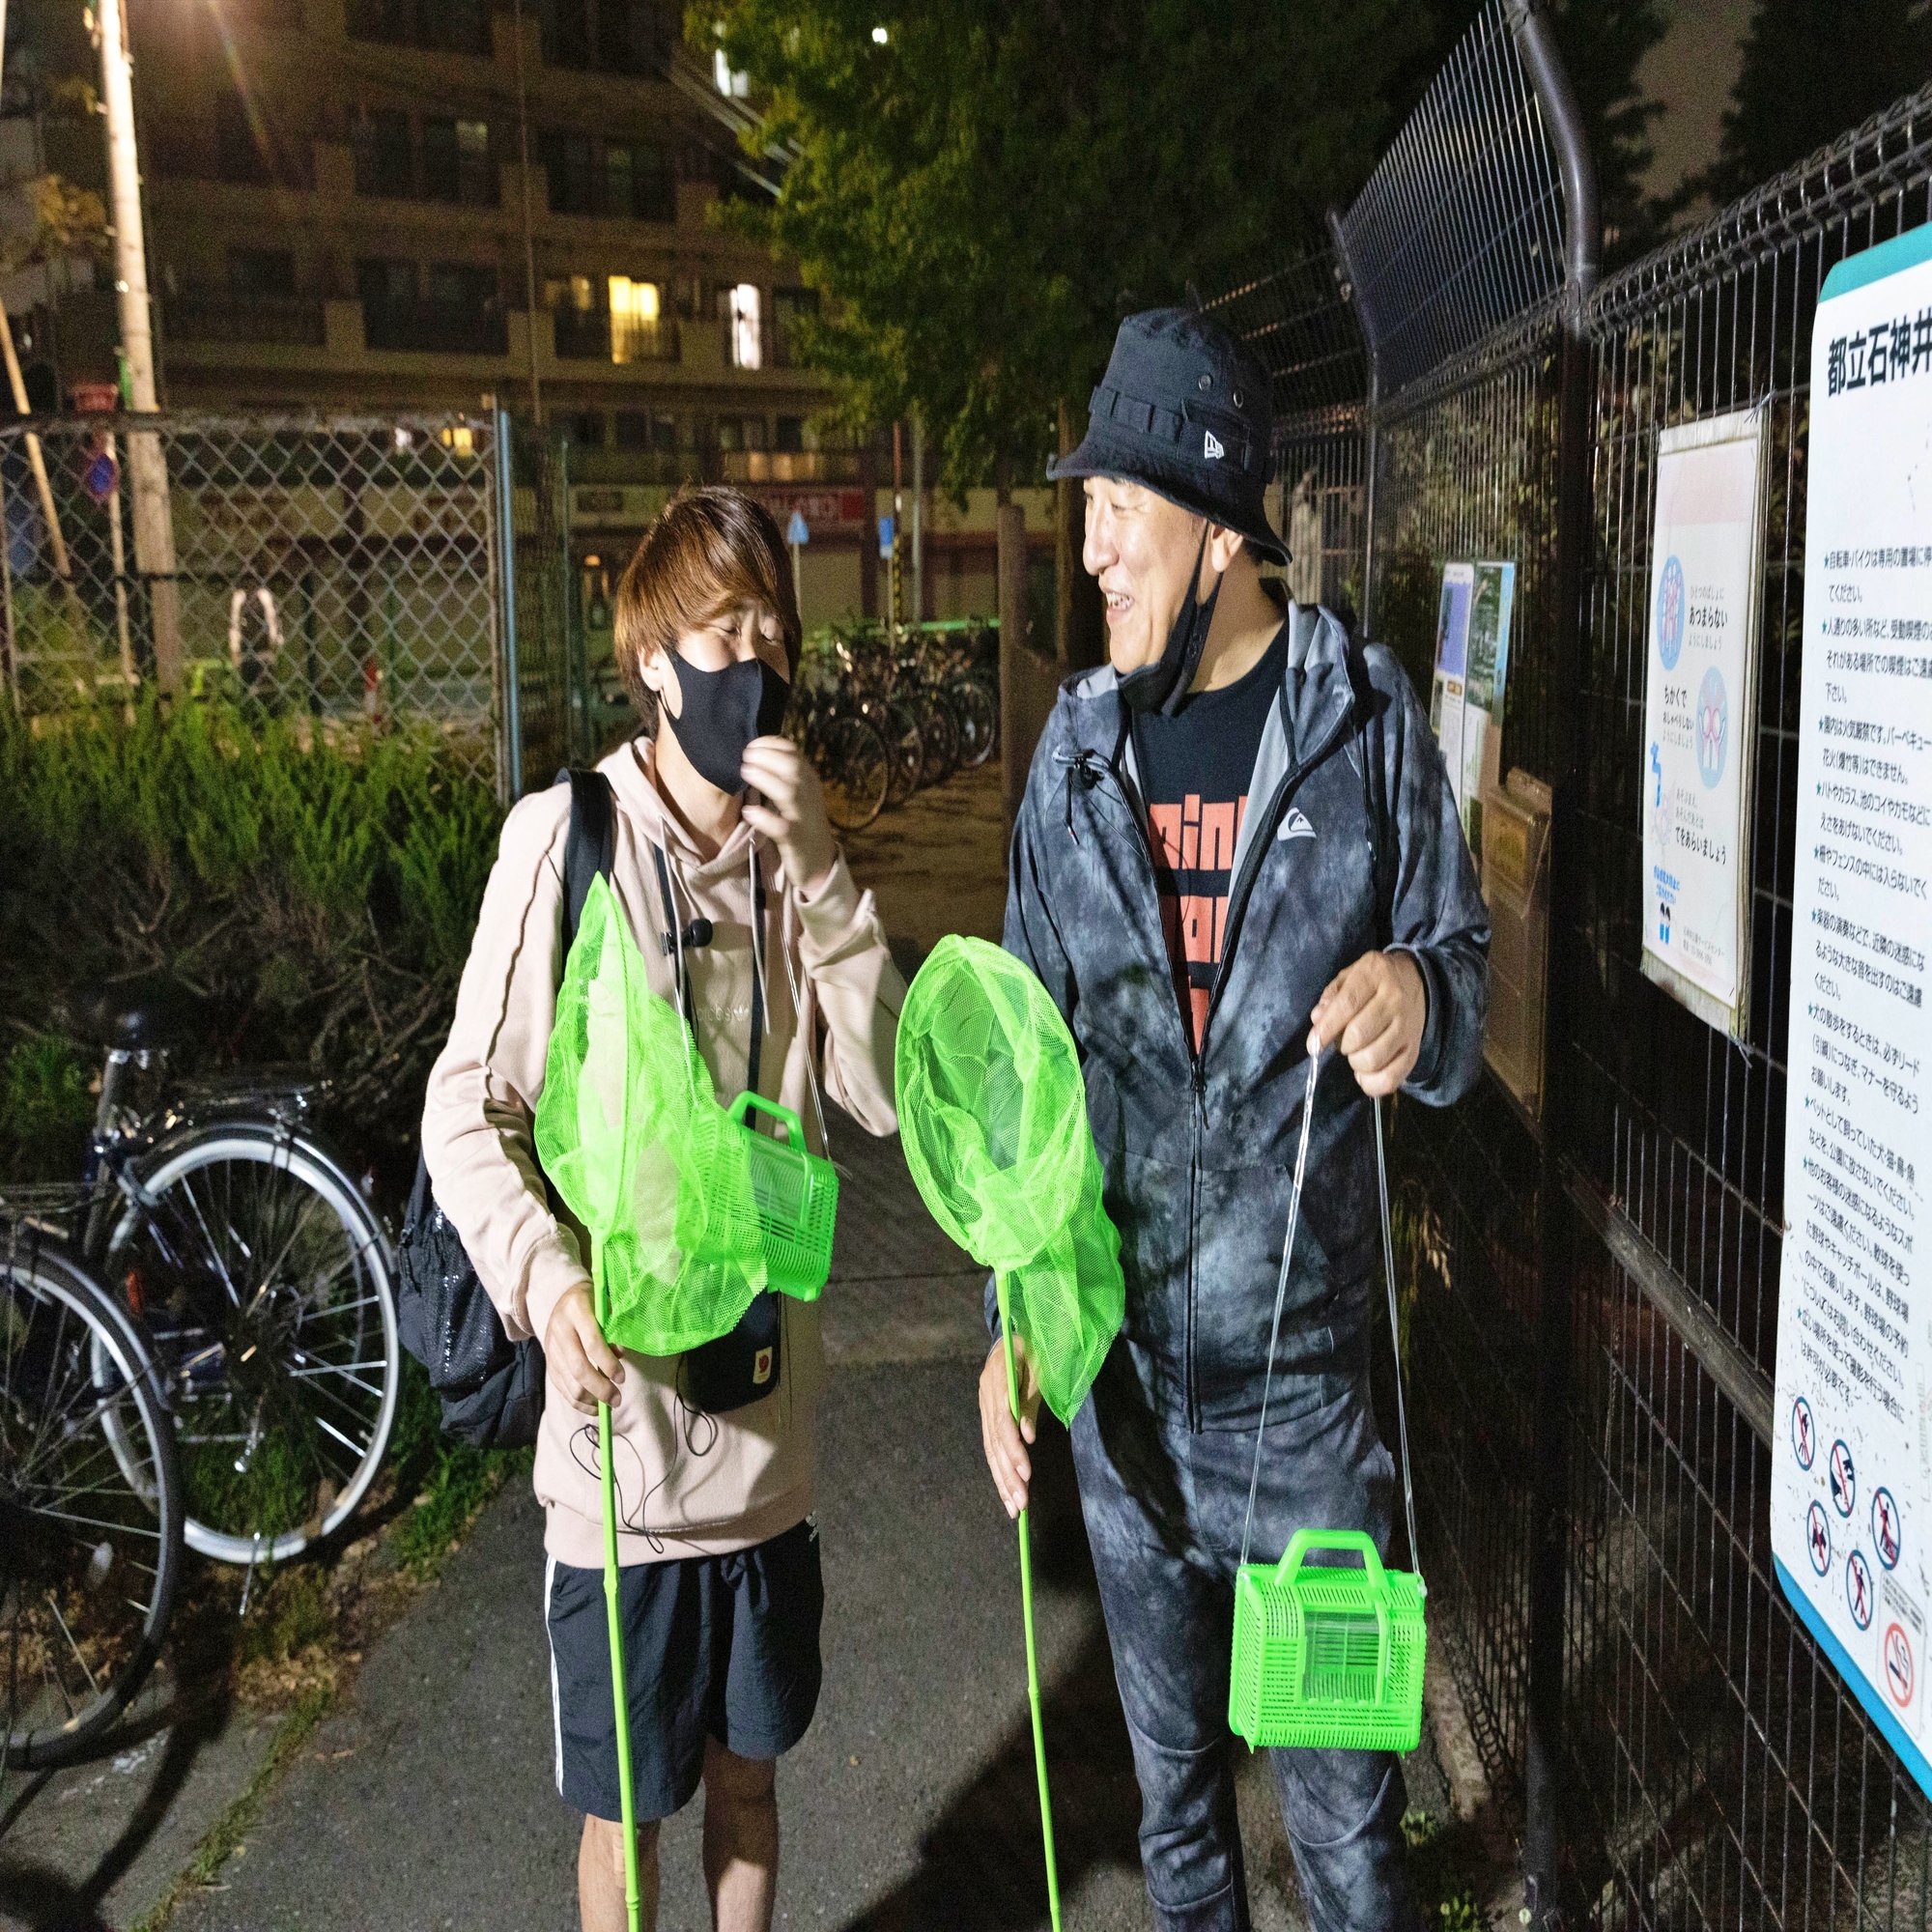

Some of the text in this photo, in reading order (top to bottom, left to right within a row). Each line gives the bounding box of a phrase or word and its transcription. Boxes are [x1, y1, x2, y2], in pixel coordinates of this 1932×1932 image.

[1828, 302, 1932, 397] 都立石神井
[1829, 583, 1862, 603] てください。
[1689, 606, 1728, 630] あつまらない
[1689, 632, 1723, 650] ようにしましょう
[1664, 685, 1688, 708] ちかくで
[1826, 682, 1847, 703] 下さい。
[1662, 711, 1694, 730] おしゃべりしない
[1675, 806, 1705, 830] あそんだあとは
[1822, 782, 1931, 827] ハトやカラス、池のコイやカモなどに
[1675, 826, 1726, 866] てをあらいましょう
[1821, 812, 1903, 856] えさをあげないでください。
[1817, 877, 1839, 901] ださい。
[1819, 844, 1927, 900] 柵やフェンスの中には入らないでく
[1816, 908, 1925, 973] 楽器の演奏などで、近隣の迷惑にな
[1814, 972, 1841, 1002] ください。
[1815, 939, 1923, 1009] るような大きな音を出すのはご遠慮
[1813, 1003, 1919, 1078] 犬の散歩をするときは、必ずリード
[1810, 1065, 1851, 1107] お願いします。
[1808, 1126, 1916, 1221] などを、公園に放さないでください。
[1807, 1157, 1914, 1254] 他のお客様の迷惑になるようなスポ
[1805, 1219, 1909, 1323] た野球やキャッチボールは、野球場
[1804, 1249, 1909, 1359] の中でお願いします。野球場の予約
